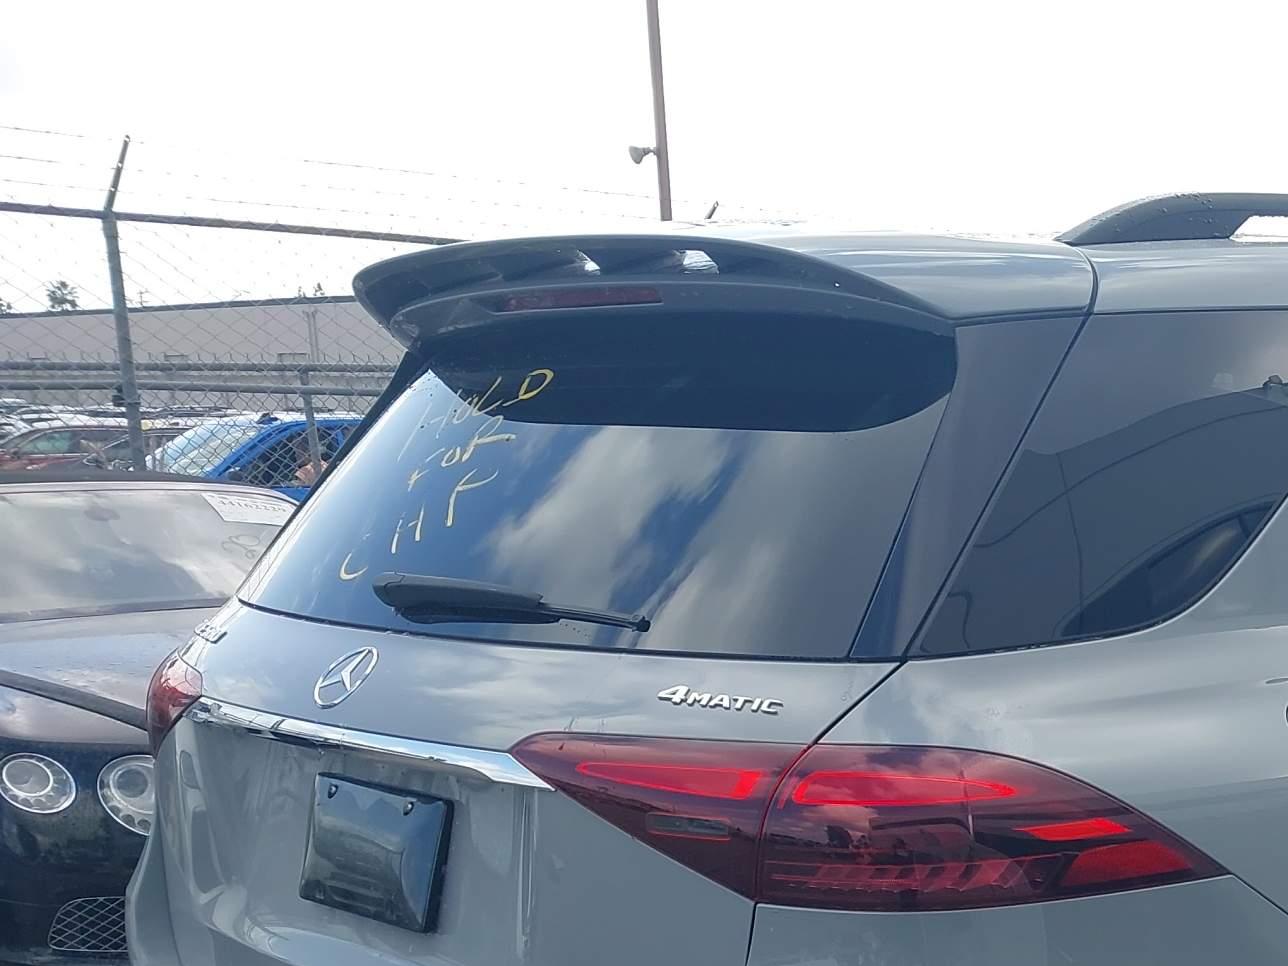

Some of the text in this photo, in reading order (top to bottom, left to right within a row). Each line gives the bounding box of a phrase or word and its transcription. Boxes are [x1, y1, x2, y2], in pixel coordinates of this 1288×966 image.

[397, 368, 555, 462] HOLD
[406, 414, 517, 493] FOR
[657, 684, 784, 715] 4MATIC
